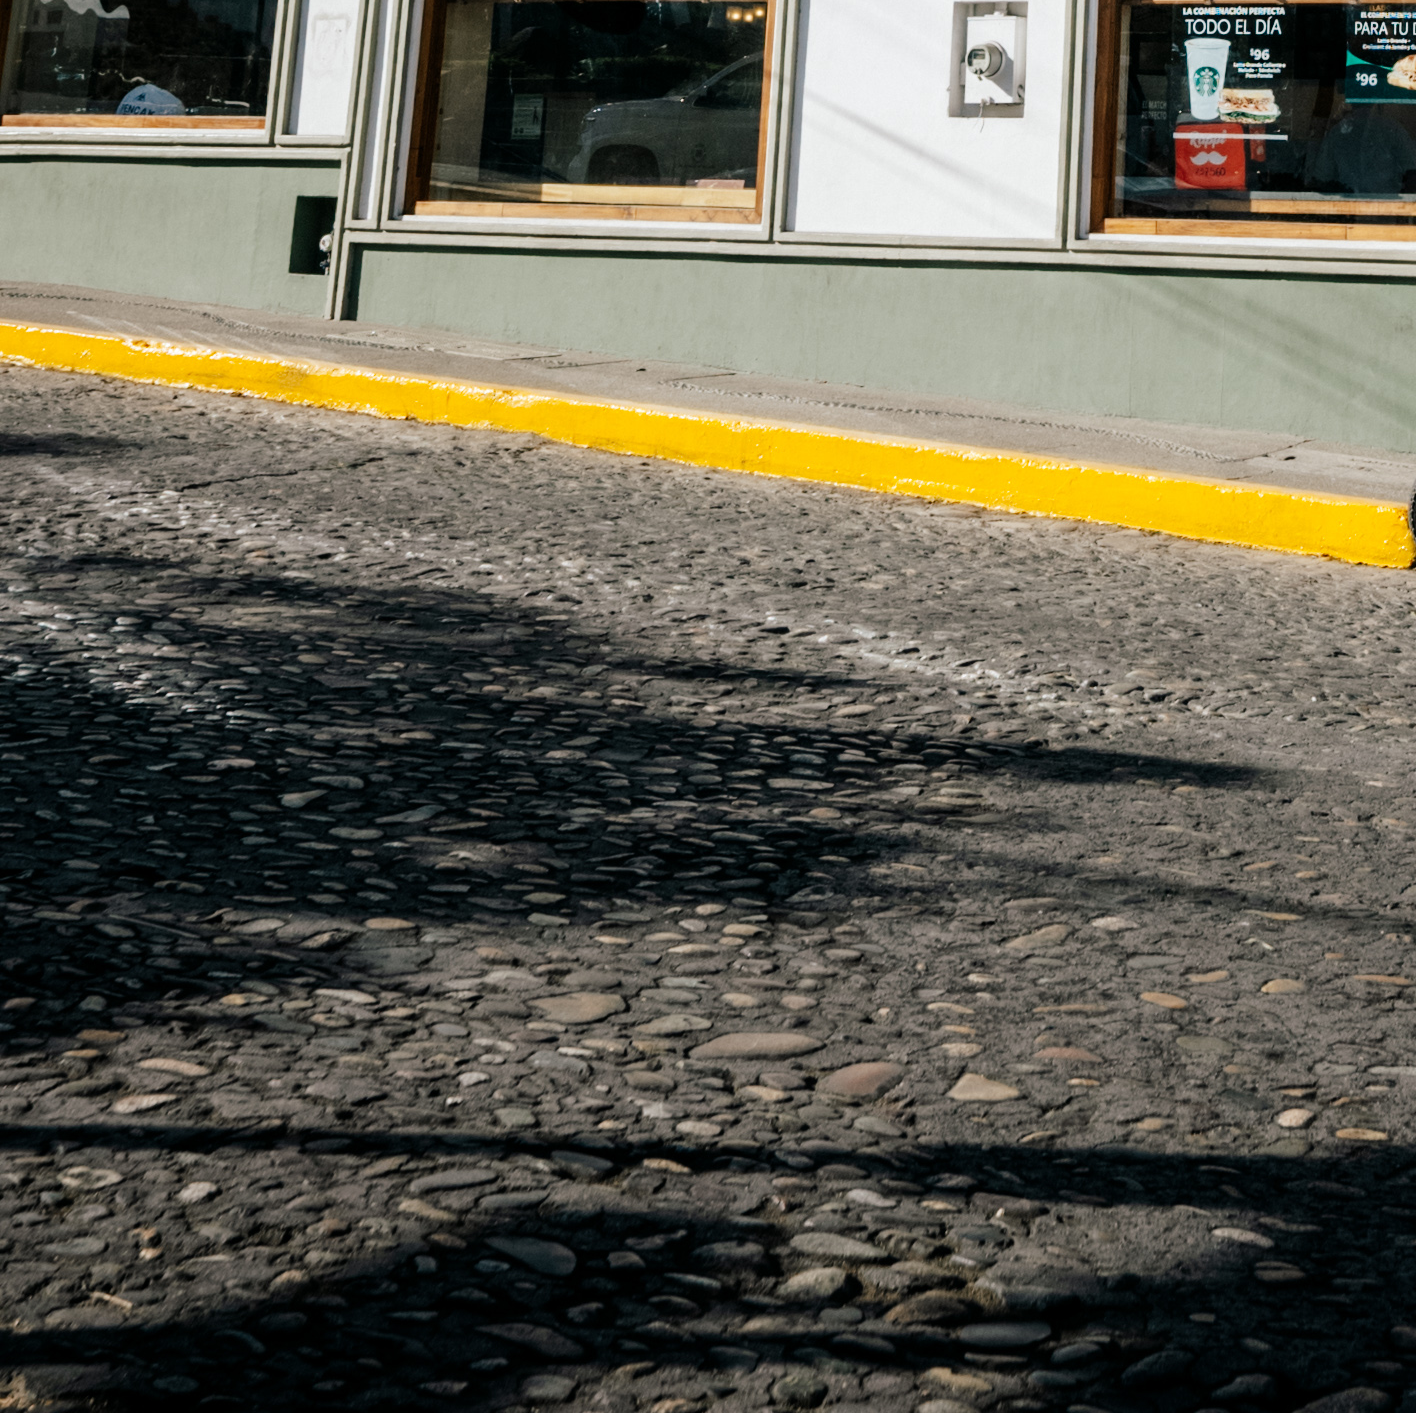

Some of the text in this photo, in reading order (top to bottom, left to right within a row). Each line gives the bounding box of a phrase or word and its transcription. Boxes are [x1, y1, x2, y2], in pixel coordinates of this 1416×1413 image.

[1182, 7, 1193, 15] LA
[1248, 7, 1286, 15] PERFECTA
[1184, 16, 1282, 35] TODO EL DÍA
[1354, 21, 1389, 35] PARA
[1391, 21, 1409, 36] TU
[1250, 48, 1270, 60] $96
[1356, 72, 1378, 86] $96
